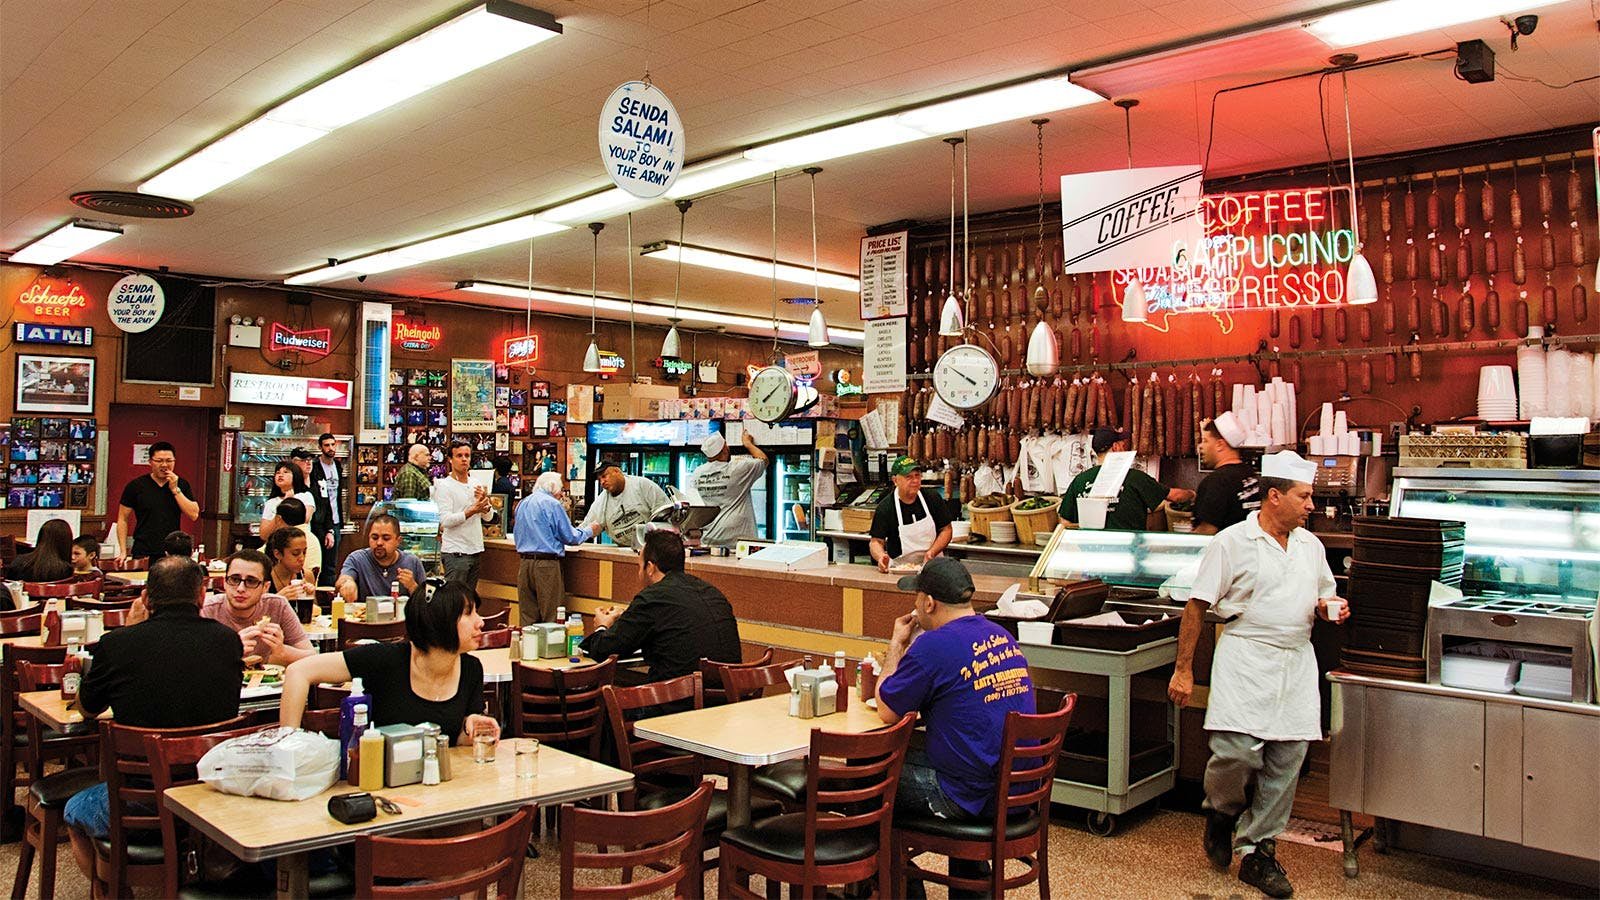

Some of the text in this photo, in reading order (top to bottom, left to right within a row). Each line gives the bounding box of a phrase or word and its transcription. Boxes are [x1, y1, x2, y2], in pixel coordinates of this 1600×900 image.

[612, 116, 673, 146] SALAMI
[636, 142, 651, 153] TO
[609, 145, 674, 172] YOUR BOY IN
[617, 164, 670, 186] THE ARMY
[1097, 187, 1180, 244] COFFEE
[1195, 191, 1324, 228] COFFEE
[868, 236, 902, 249] PRICE LIST
[1173, 230, 1353, 269] CAPPUCCINO
[20, 285, 86, 306] Schaefer
[116, 295, 155, 304] SALAMI
[35, 307, 70, 316] BEER
[28, 328, 83, 341] ATM
[275, 332, 328, 349] Budweiser
[395, 323, 440, 341] Rheingold
[663, 360, 692, 369] Heineken
[234, 379, 305, 392] RESTROOMS
[252, 391, 286, 401] ATM
[972, 640, 988, 656] Send
[990, 635, 1009, 648] Salami
[960, 666, 972, 681] To
[972, 660, 989, 677] Your
[988, 652, 1000, 666] Boy
[1005, 646, 1013, 658] the
[974, 674, 996, 690] KATZ'S
